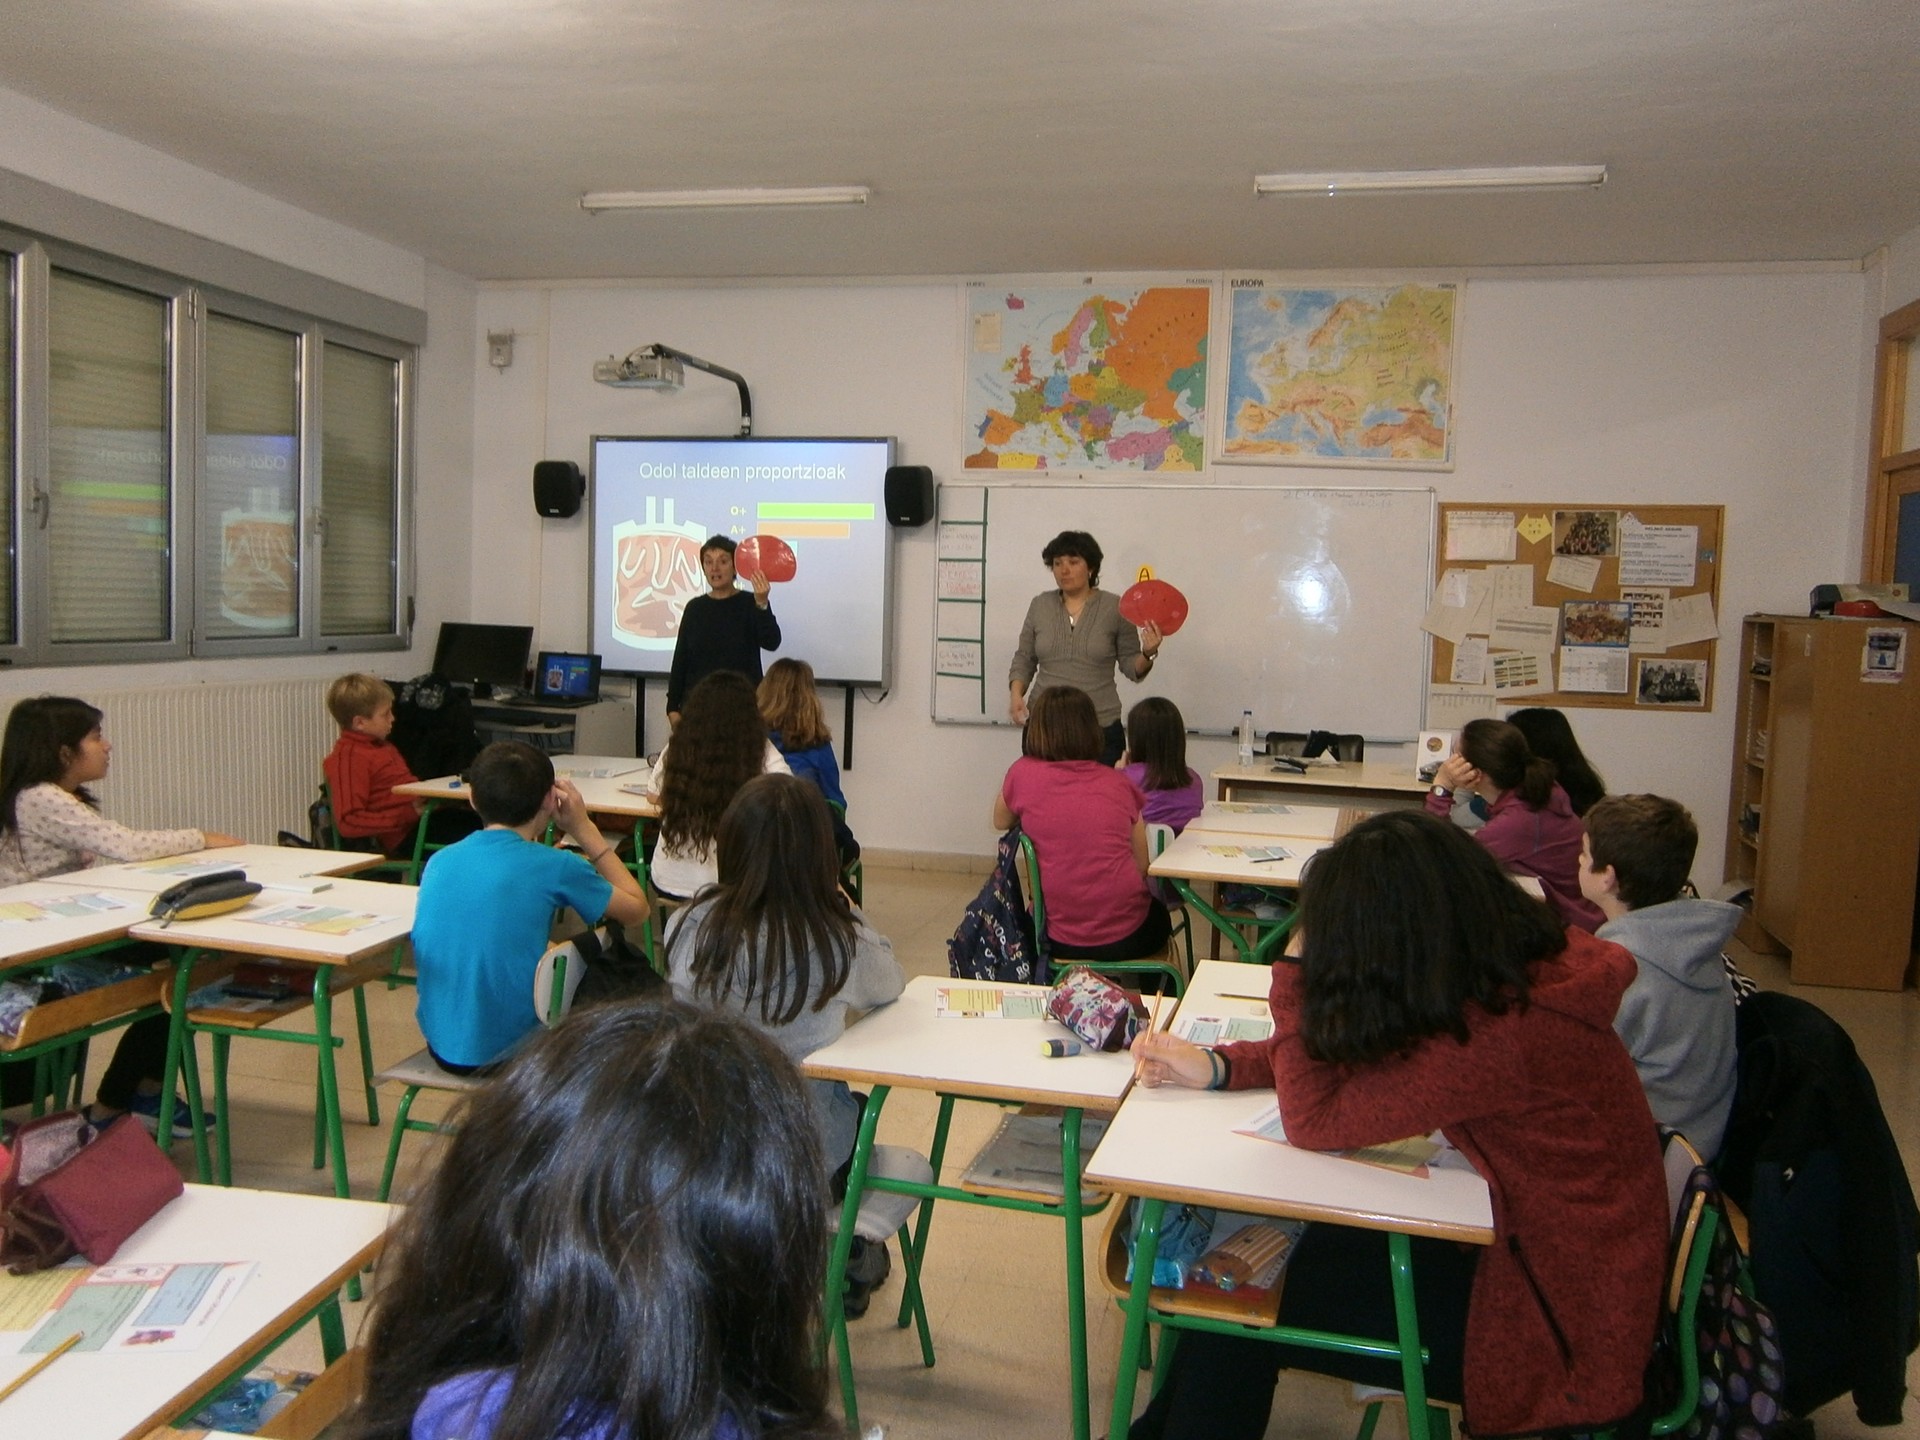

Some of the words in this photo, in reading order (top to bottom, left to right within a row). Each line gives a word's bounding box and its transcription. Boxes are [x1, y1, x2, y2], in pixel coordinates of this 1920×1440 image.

[1230, 279, 1264, 288] EUROPA
[639, 462, 677, 480] Odol
[682, 463, 740, 480] taldeen
[745, 463, 846, 483] proportzioak
[730, 524, 746, 535] A+
[1139, 567, 1150, 583] A
